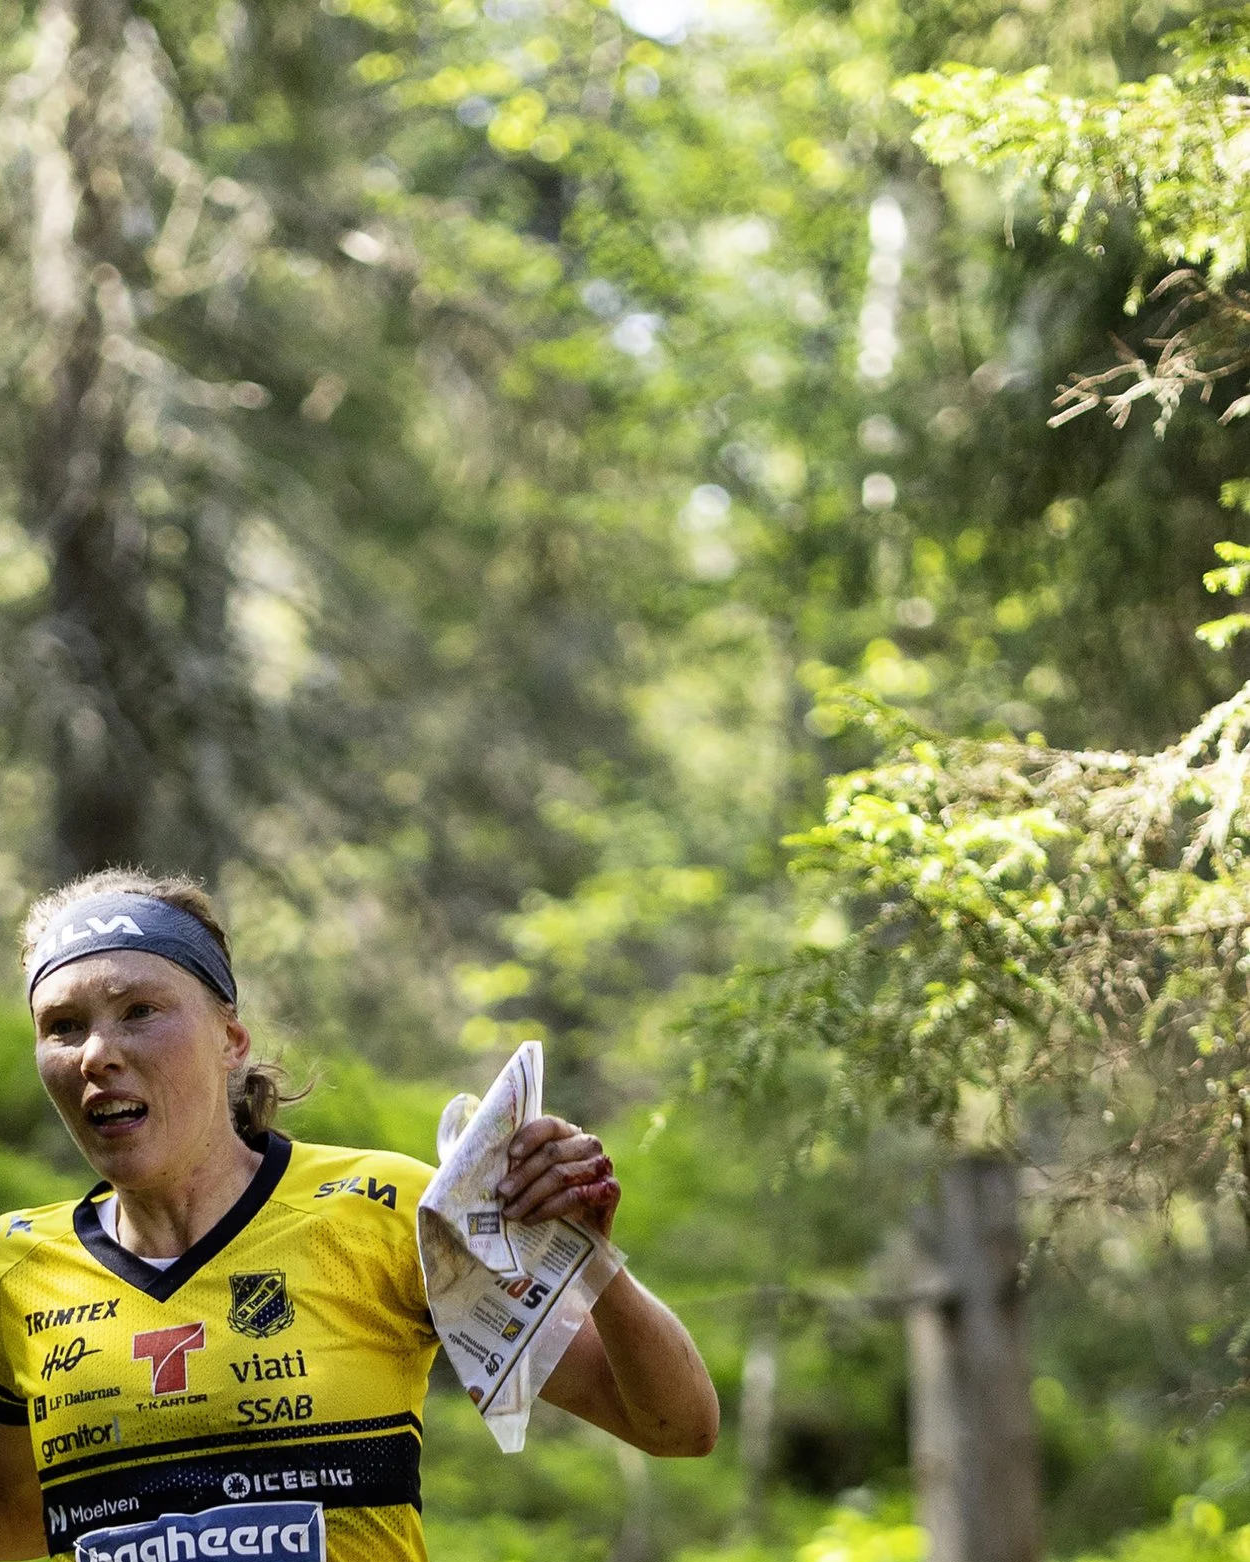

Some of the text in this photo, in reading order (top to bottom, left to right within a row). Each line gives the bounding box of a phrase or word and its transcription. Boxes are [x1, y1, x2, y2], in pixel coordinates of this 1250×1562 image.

[313, 1176, 397, 1211] SILVA
[24, 1297, 121, 1337] TRIMTEX
[459, 1331, 491, 1358] kommun
[229, 1348, 309, 1384] viati
[49, 1386, 121, 1412] LF Dalarnas
[237, 1394, 313, 1427] SSAB
[41, 1423, 113, 1464] granitor
[253, 1468, 353, 1493] ICEBUG
[70, 1496, 140, 1524] Moelven
